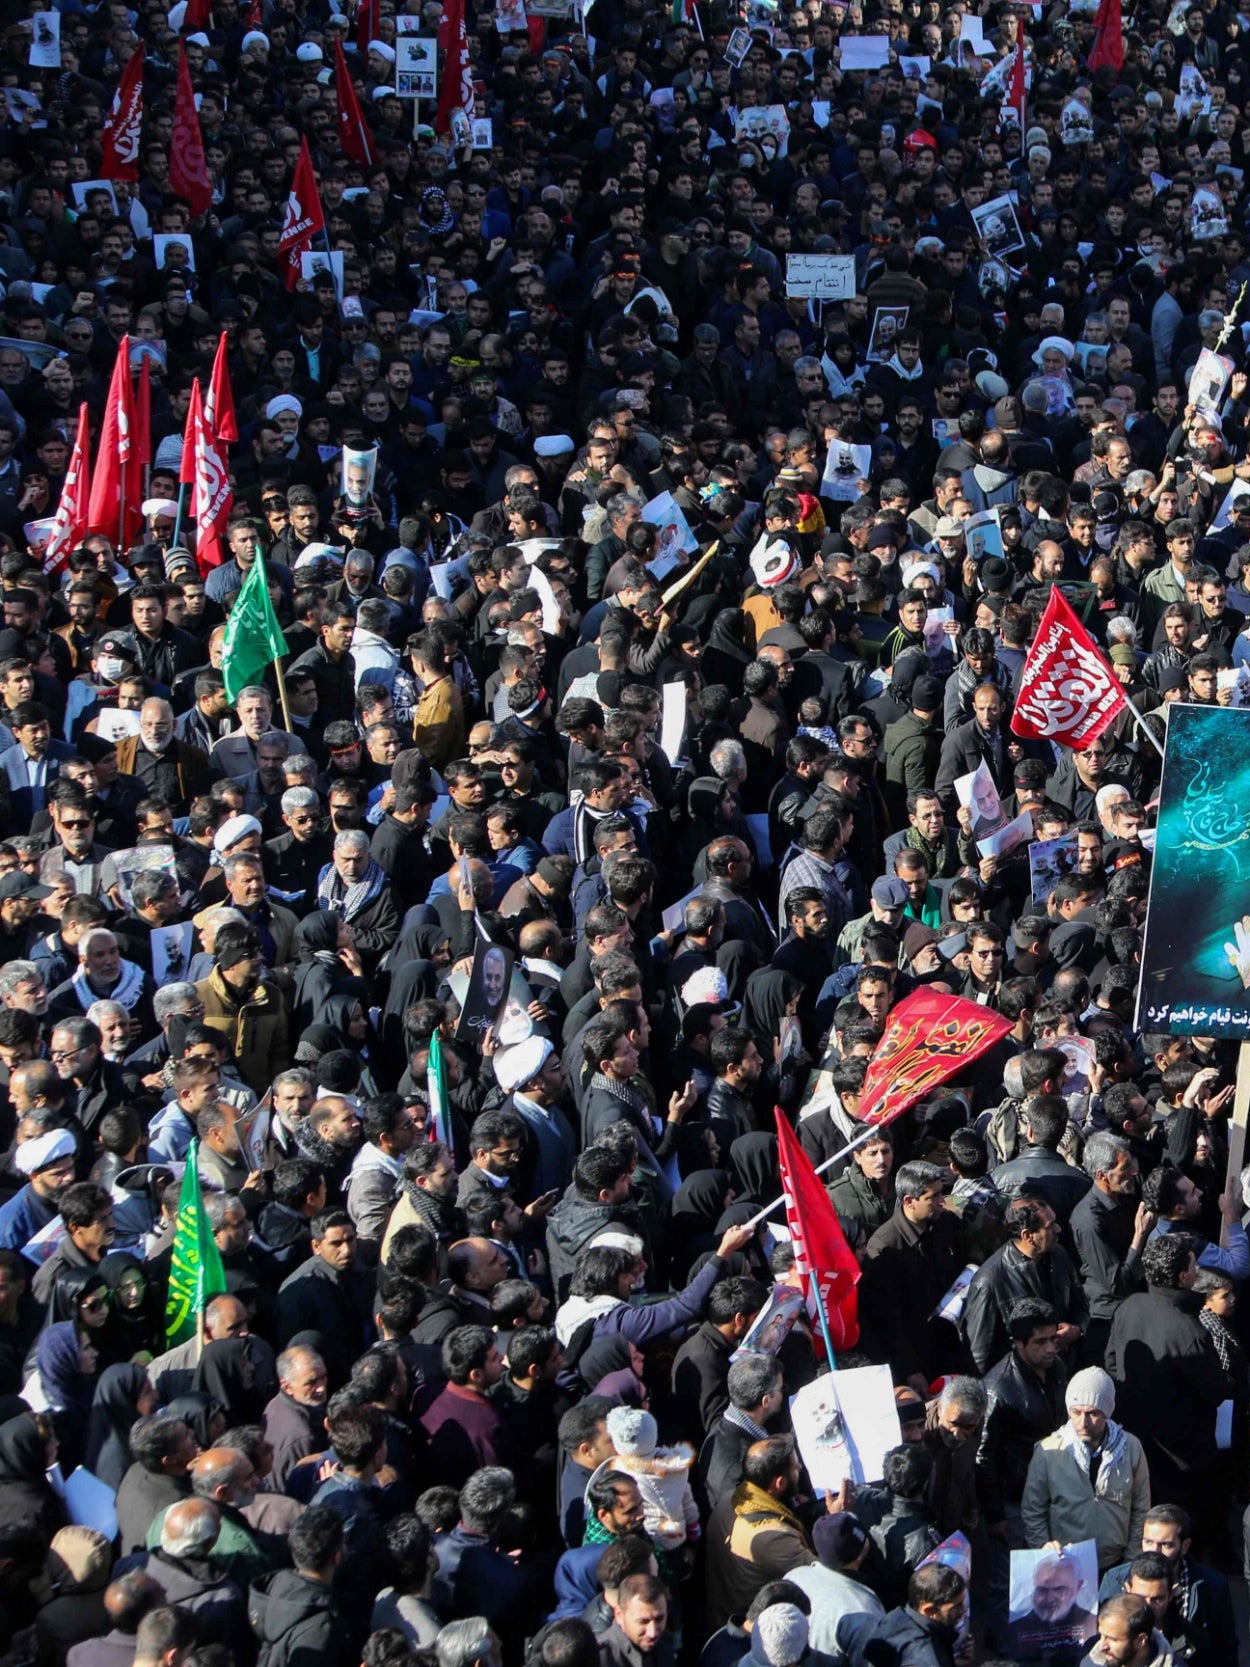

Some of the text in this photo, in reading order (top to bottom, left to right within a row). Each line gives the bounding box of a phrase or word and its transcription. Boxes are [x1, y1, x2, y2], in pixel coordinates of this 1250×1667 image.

[1071, 711, 1102, 739] HARD
[1147, 1003, 1170, 1023] کرد
[1169, 1005, 1208, 1025] خواهیم
[1208, 1007, 1231, 1026] قیام
